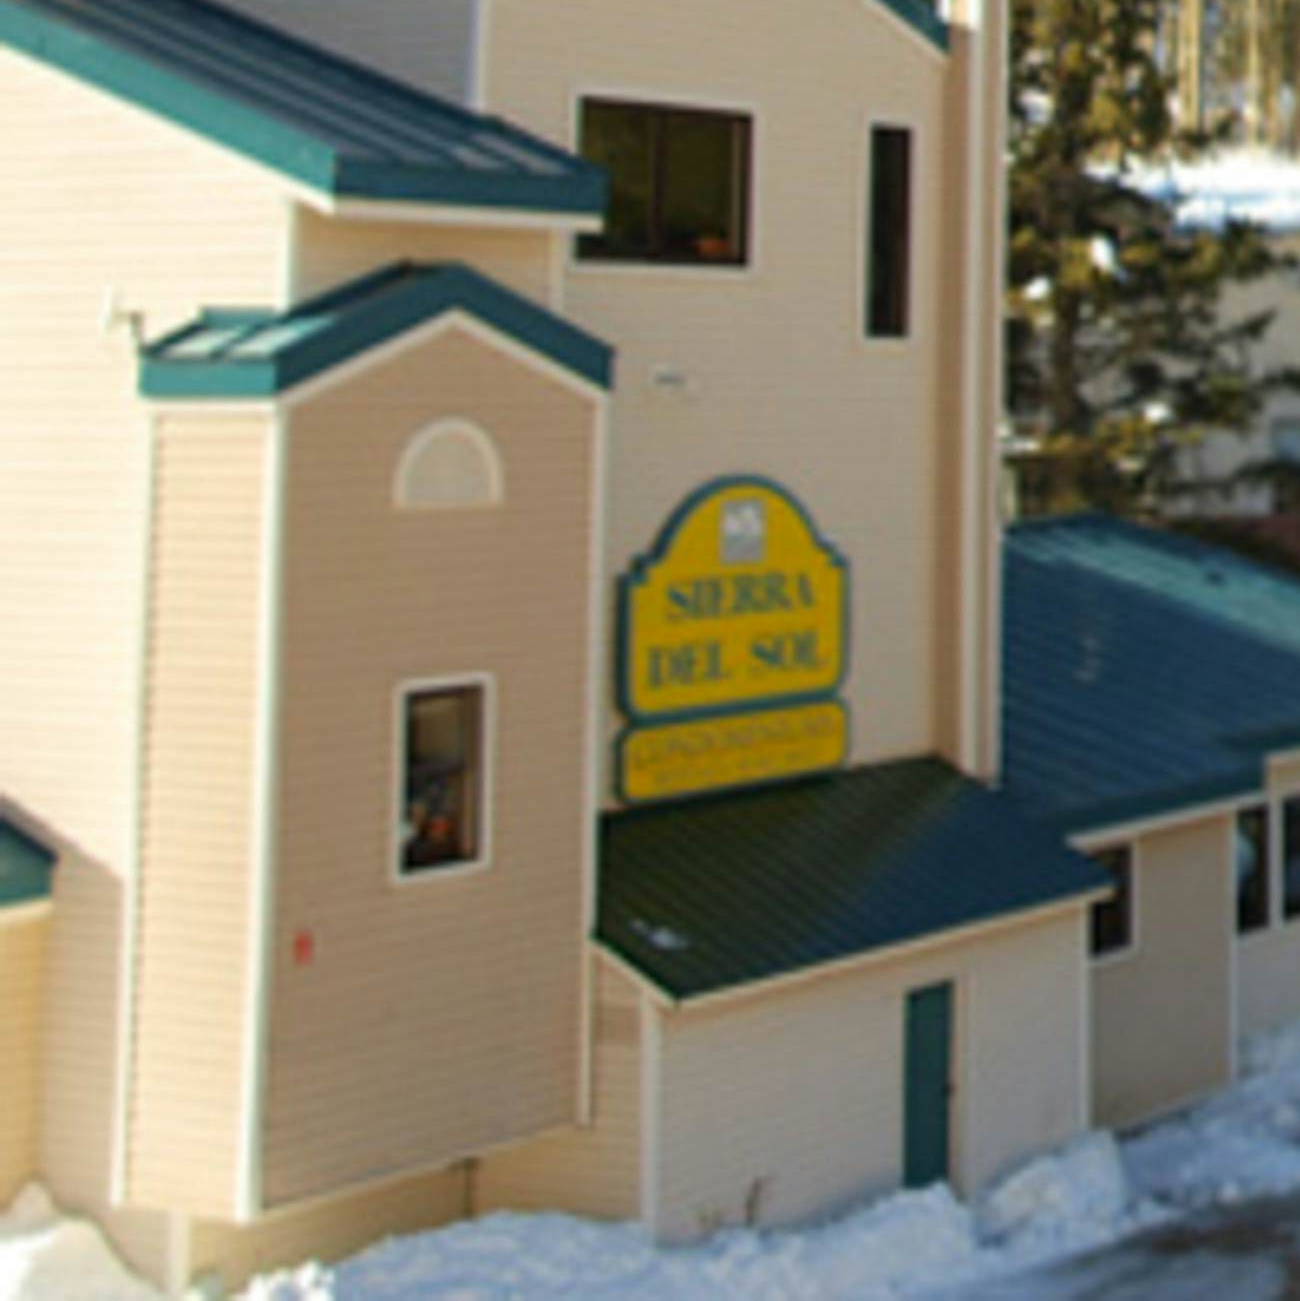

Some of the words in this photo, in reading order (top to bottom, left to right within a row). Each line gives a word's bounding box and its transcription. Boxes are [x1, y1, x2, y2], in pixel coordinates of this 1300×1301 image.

[665, 569, 814, 623] SIERRA
[647, 640, 730, 688] DEL
[748, 630, 826, 678] SOL
